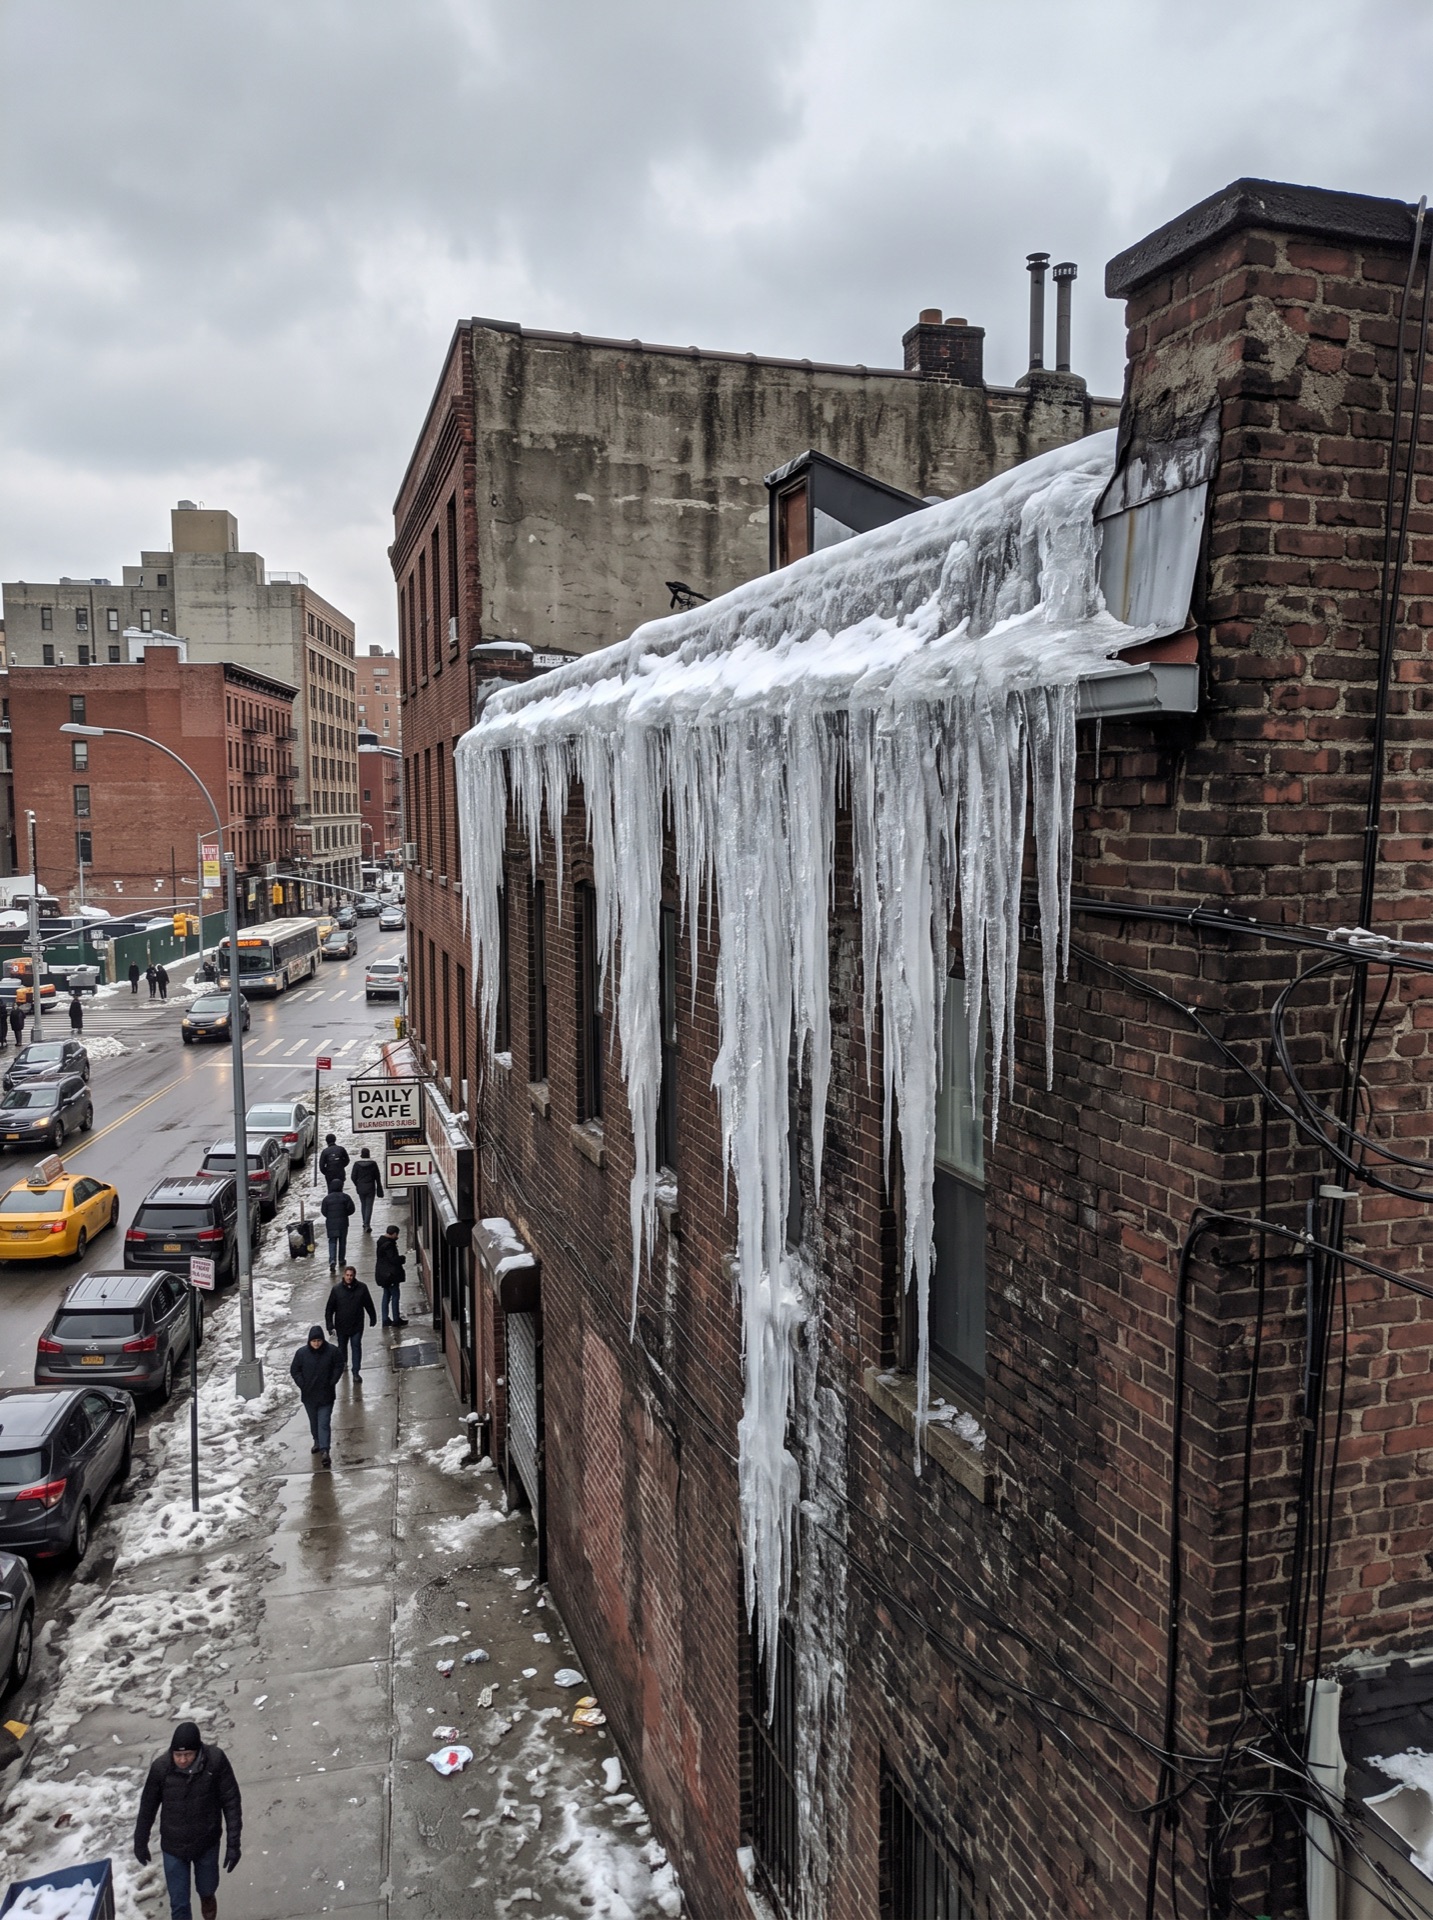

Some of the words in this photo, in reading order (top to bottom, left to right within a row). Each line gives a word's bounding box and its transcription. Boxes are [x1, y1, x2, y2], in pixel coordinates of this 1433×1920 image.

[358, 1089, 413, 1103] DAILY
[361, 1104, 411, 1119] CAFE
[390, 1161, 433, 1177] DELI
